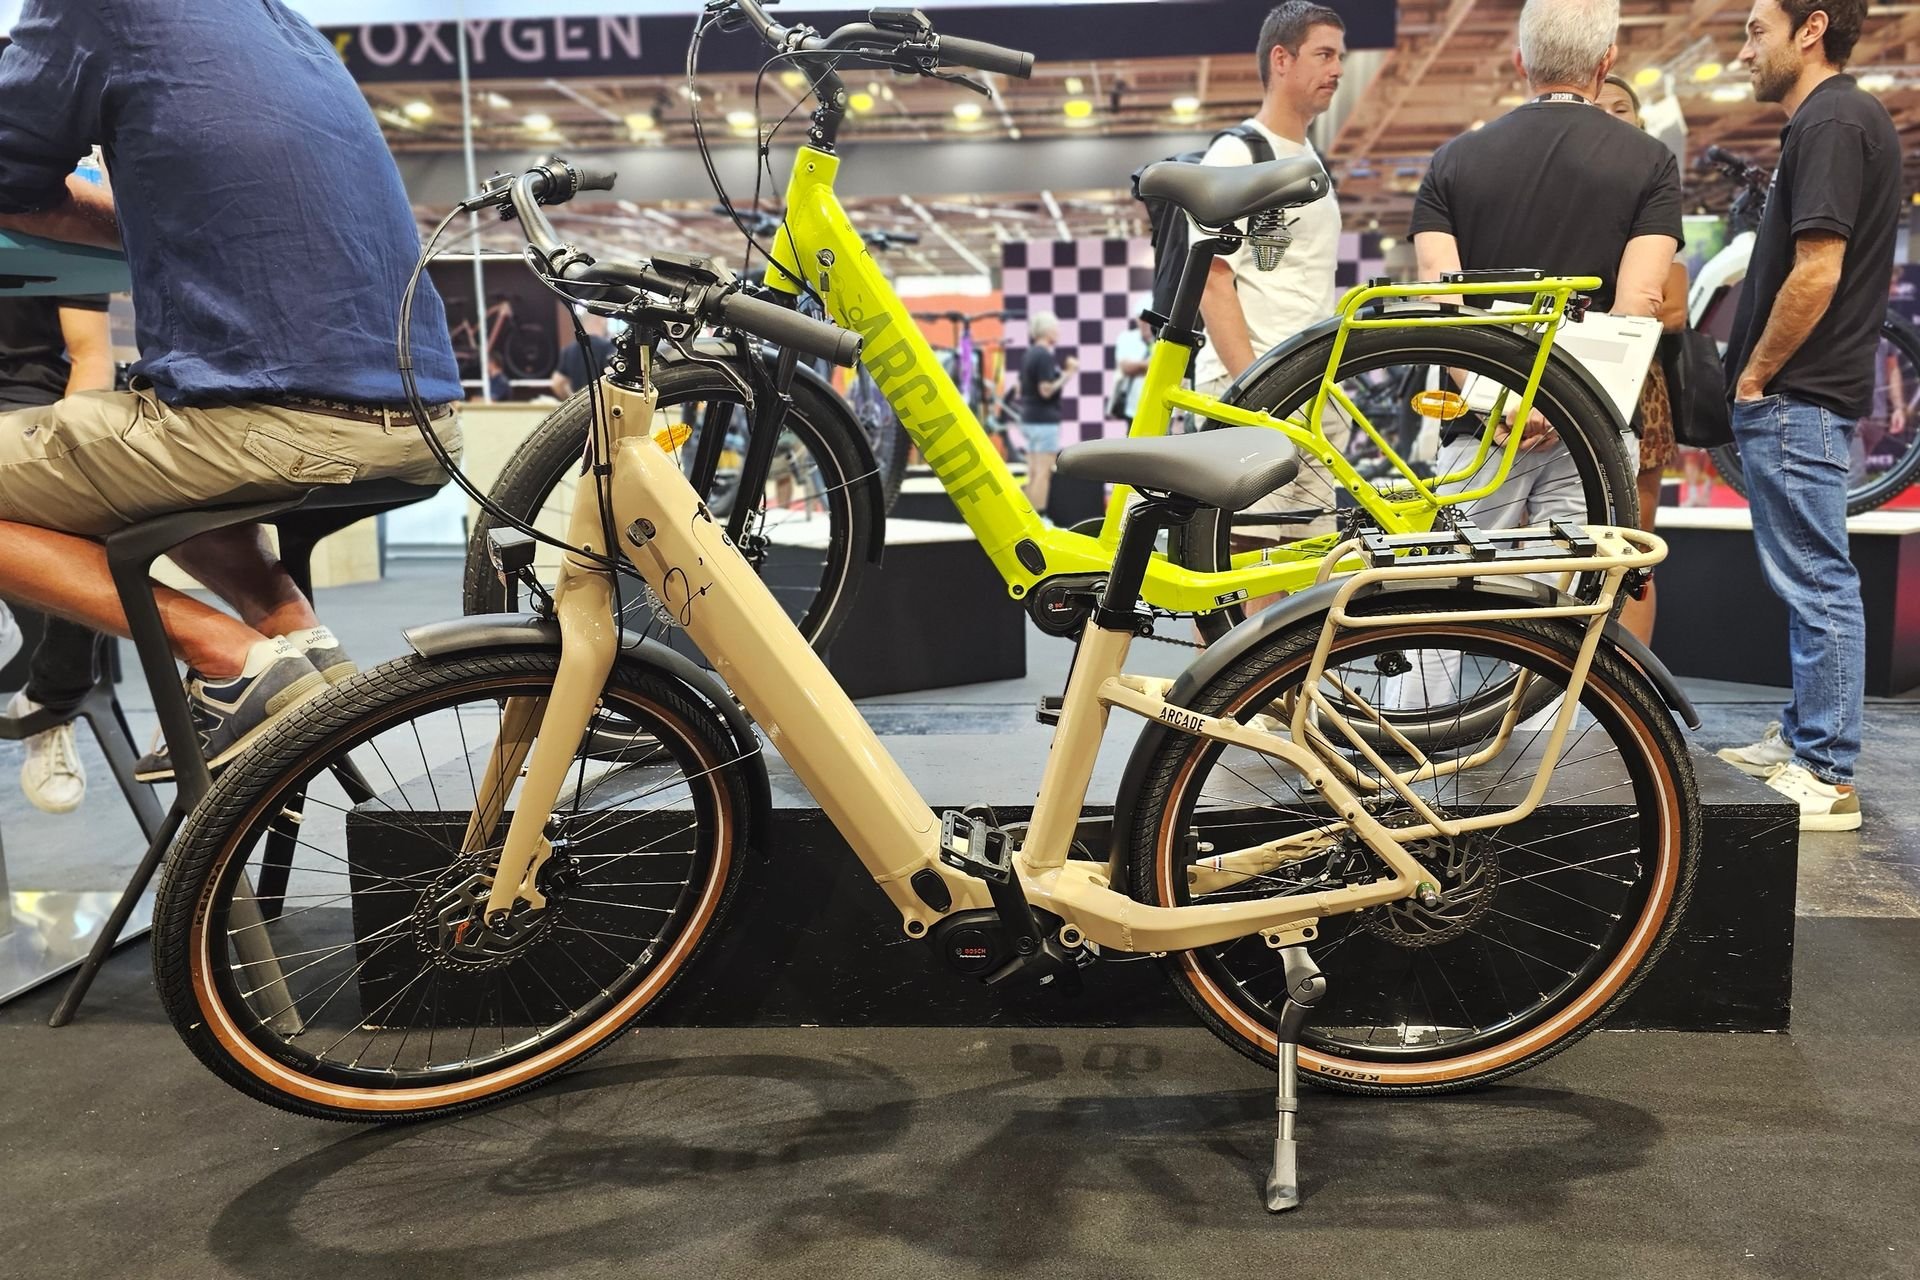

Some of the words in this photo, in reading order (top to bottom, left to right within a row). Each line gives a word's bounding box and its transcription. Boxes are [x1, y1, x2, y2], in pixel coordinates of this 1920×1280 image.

[359, 15, 642, 66] OXYGEN
[857, 311, 1003, 518] ARCADE
[1159, 706, 1206, 732] ARCADE
[195, 863, 223, 926] KENDA
[1320, 1065, 1380, 1081] KENDA
